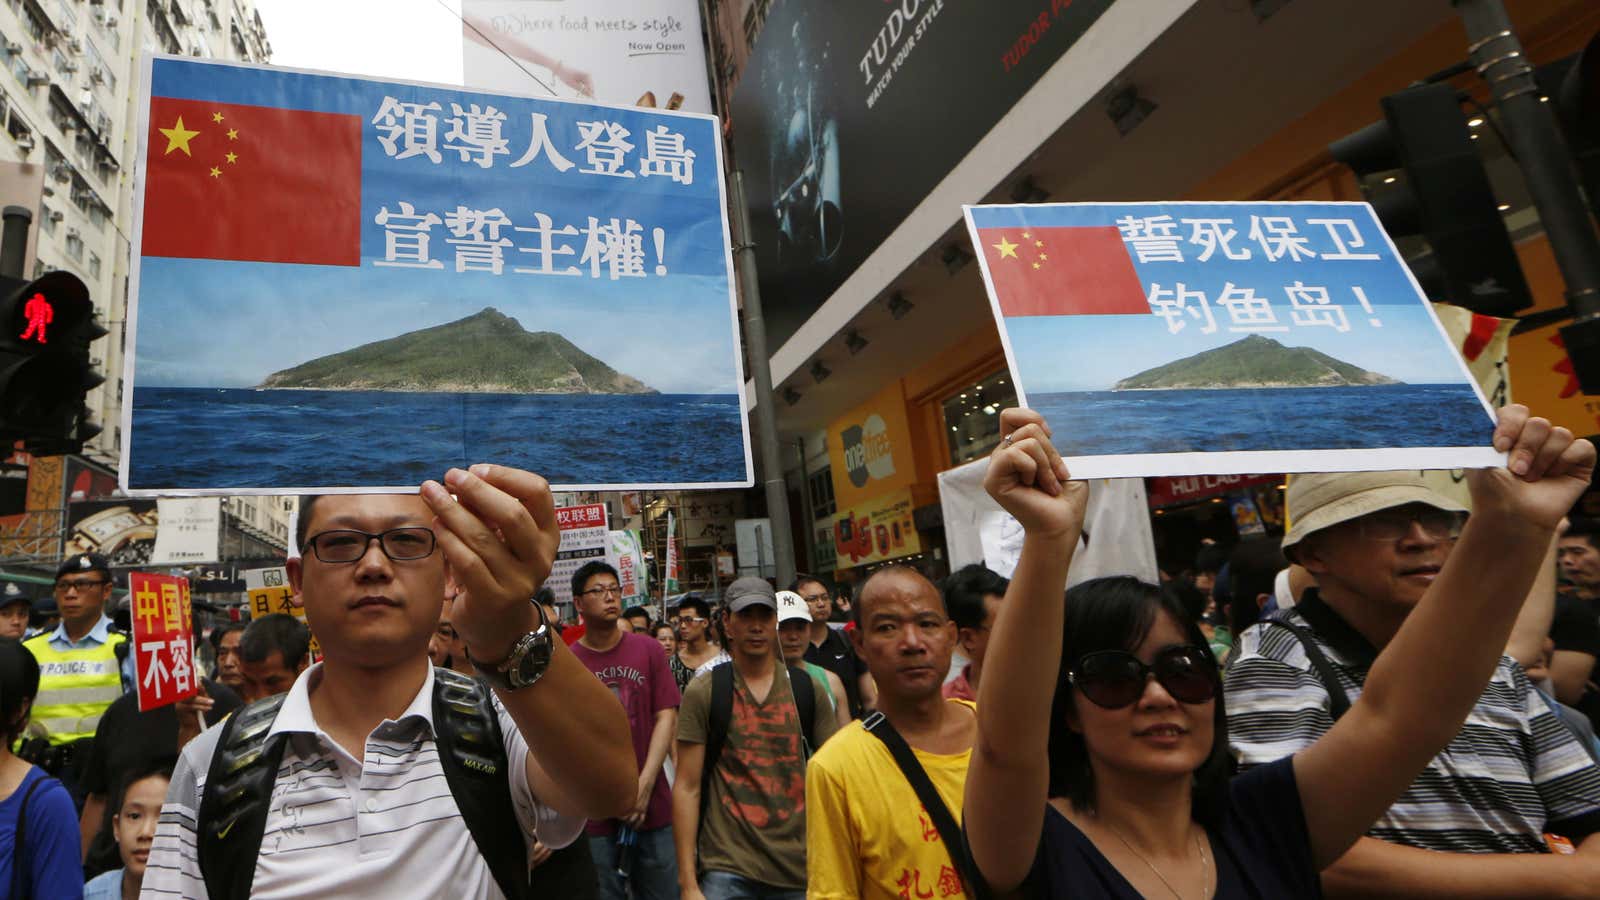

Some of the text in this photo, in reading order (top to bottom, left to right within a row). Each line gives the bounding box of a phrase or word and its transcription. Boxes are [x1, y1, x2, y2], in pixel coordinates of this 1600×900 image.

[560, 15, 589, 32] food
[643, 16, 682, 37] style
[628, 42, 686, 51] Now Open
[859, 0, 924, 85] TUDO
[1001, 11, 1050, 73] TUDOR
[866, 0, 944, 109] WATCH YOUR STYLE
[372, 95, 696, 185] 領導人登島
[373, 201, 668, 280] 宣誓主權!
[1116, 214, 1381, 263] 誓死保卫
[1147, 280, 1383, 334] 钓鱼岛!
[47, 662, 87, 674] POLICE
[464, 759, 497, 775] MAX AIR
